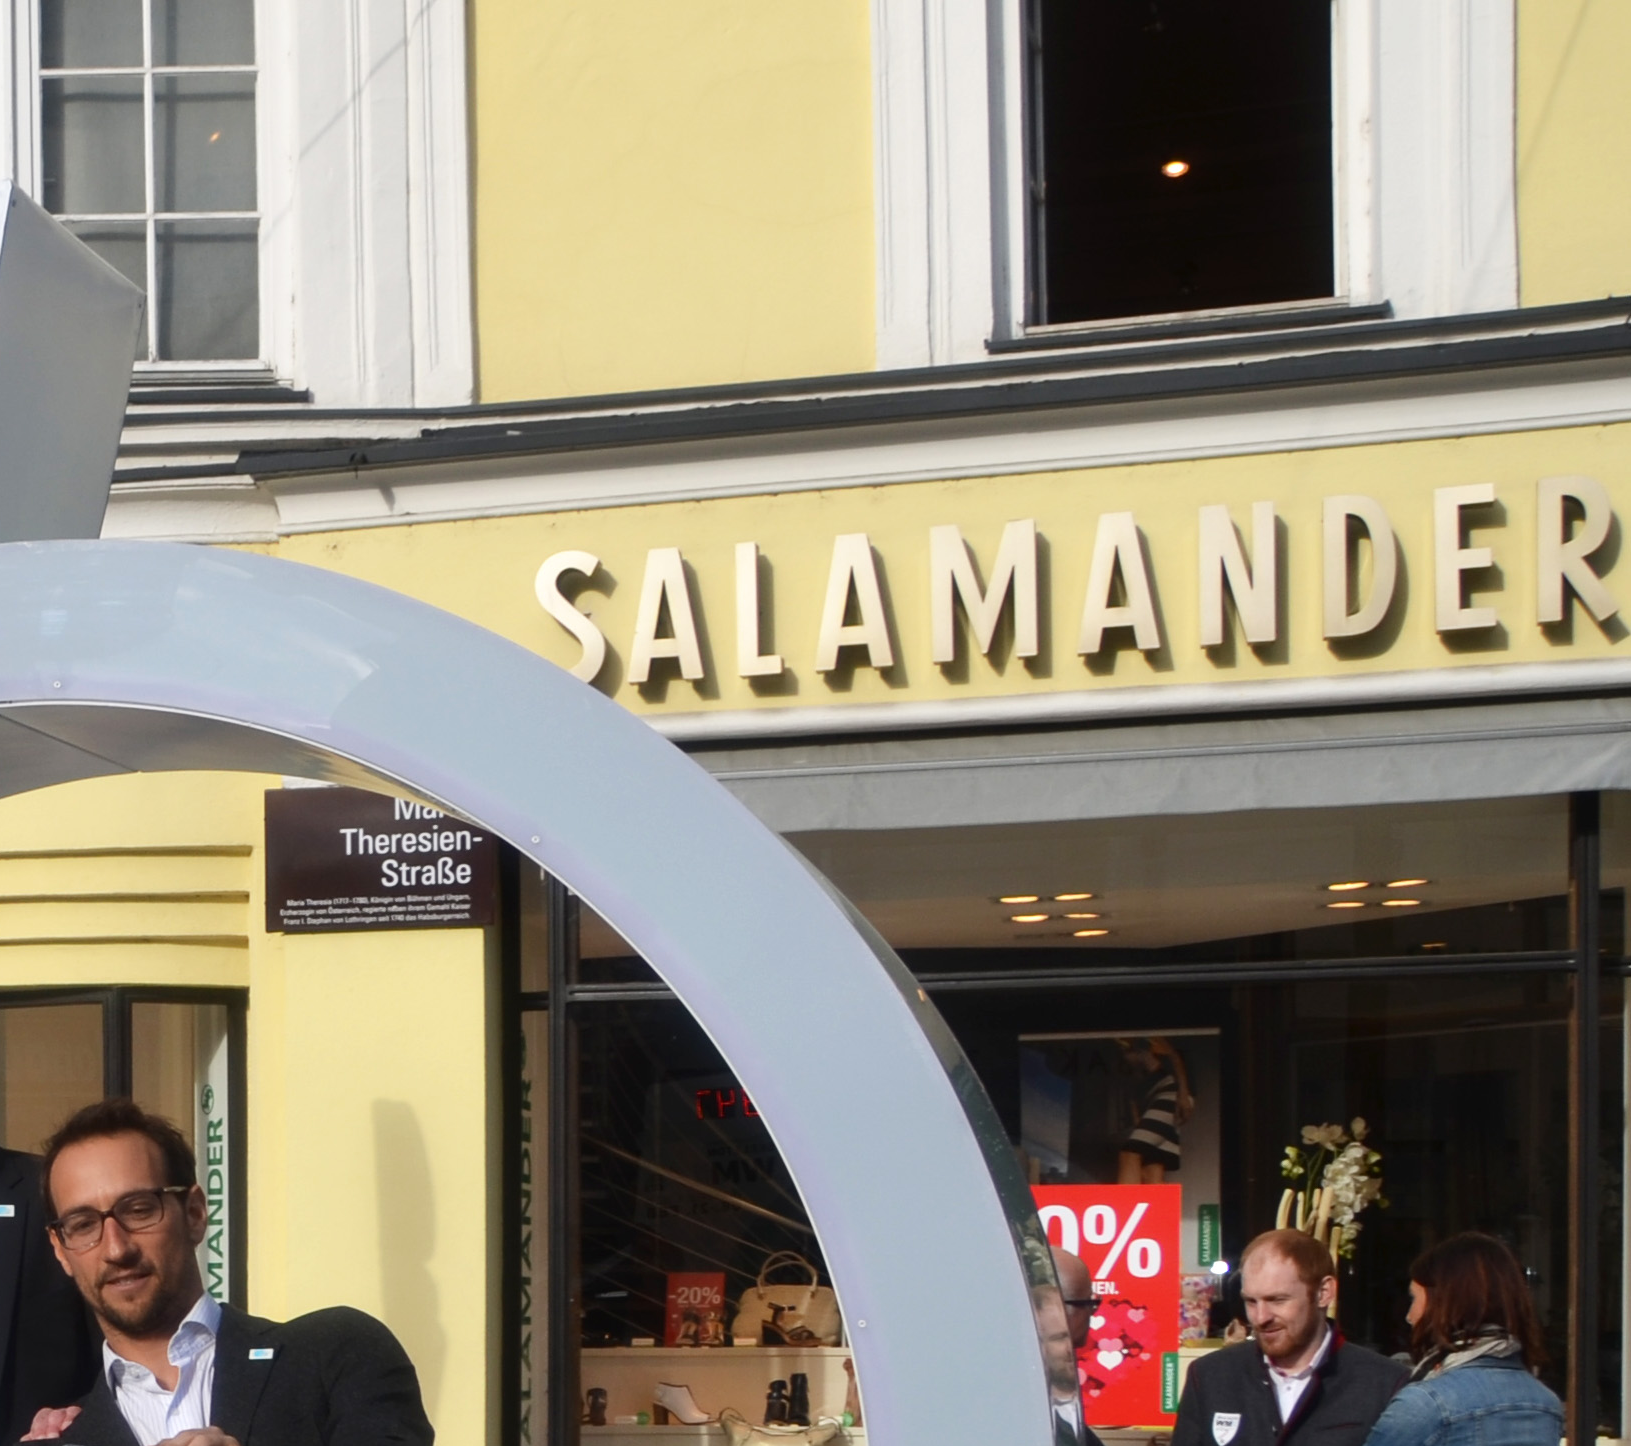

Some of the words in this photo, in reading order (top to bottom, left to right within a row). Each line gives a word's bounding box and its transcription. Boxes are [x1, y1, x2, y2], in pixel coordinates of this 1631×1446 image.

[535, 475, 1623, 684] SALAMANDER
[339, 824, 483, 856] Theresien-
[380, 856, 472, 888] Straße
[207, 1117, 224, 1299] MANDER
[1037, 1203, 1162, 1280] 0%
[668, 1286, 721, 1304] -20%
